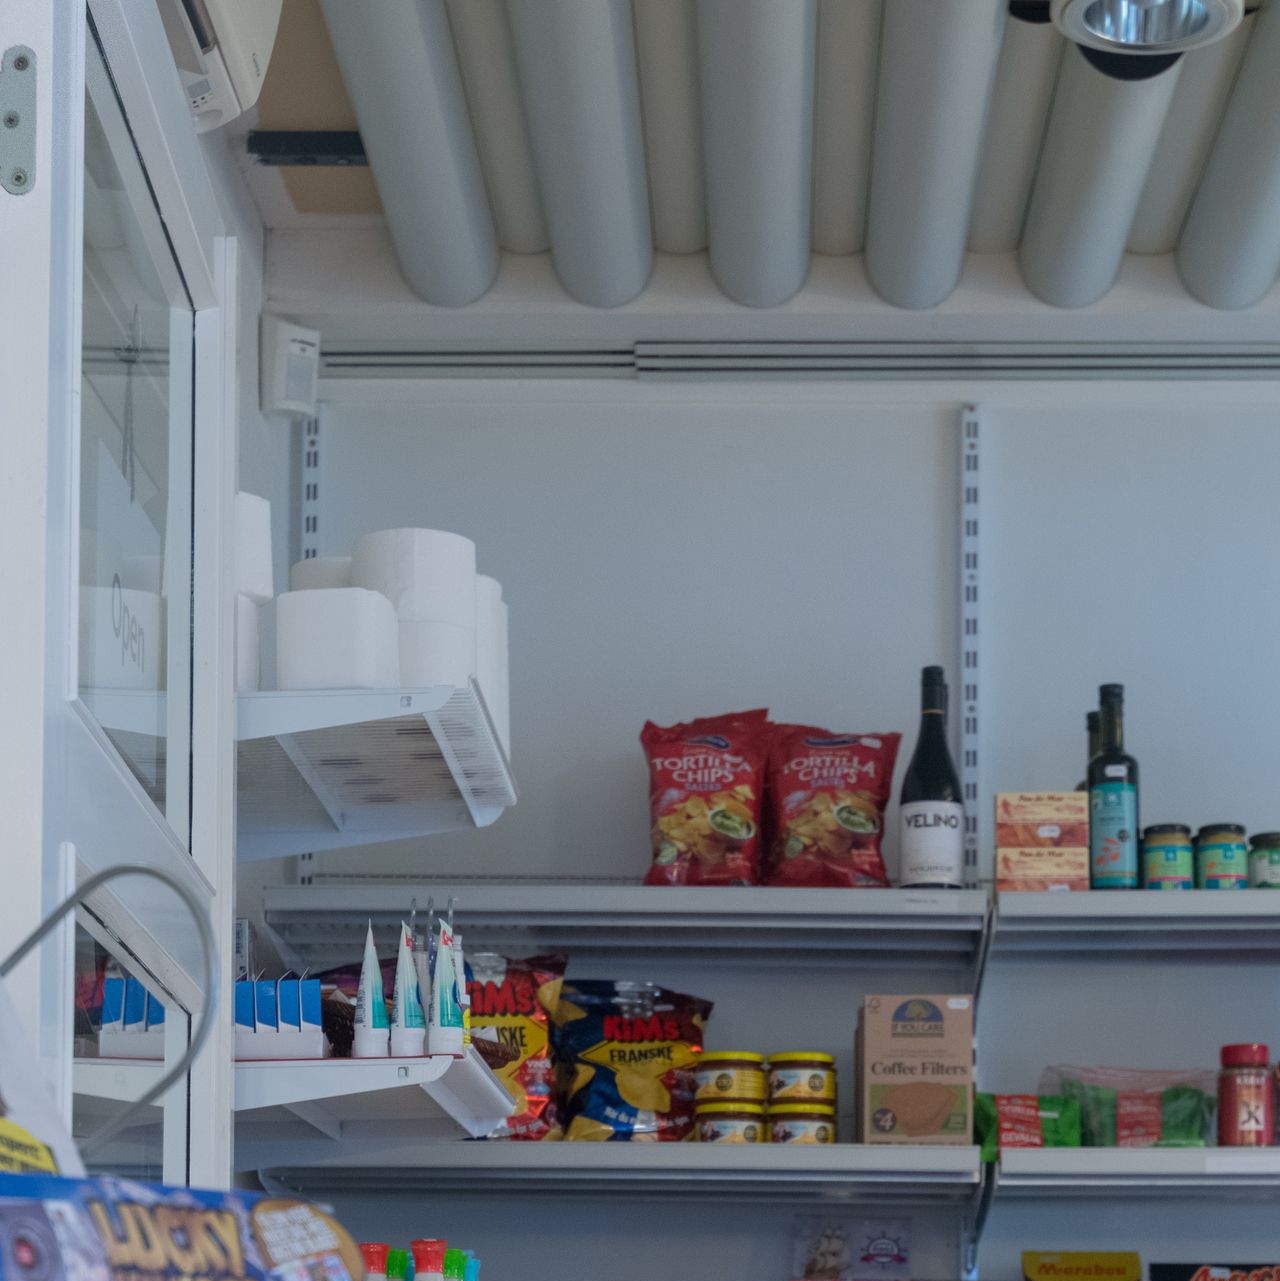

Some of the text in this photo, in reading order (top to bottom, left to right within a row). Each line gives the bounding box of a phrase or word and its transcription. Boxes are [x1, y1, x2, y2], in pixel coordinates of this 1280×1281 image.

[111, 572, 145, 673] Open
[652, 753, 752, 773] TORTILLA
[784, 755, 876, 779] TORTILLA
[672, 768, 735, 783] CHIPS
[798, 767, 858, 783] CHIPS
[905, 813, 959, 829] VELINO
[467, 981, 535, 1014] iMs
[609, 1047, 674, 1063] FRANSKE
[871, 1062, 967, 1075] Coffee Filters
[1038, 1264, 1127, 1277] Marabou
